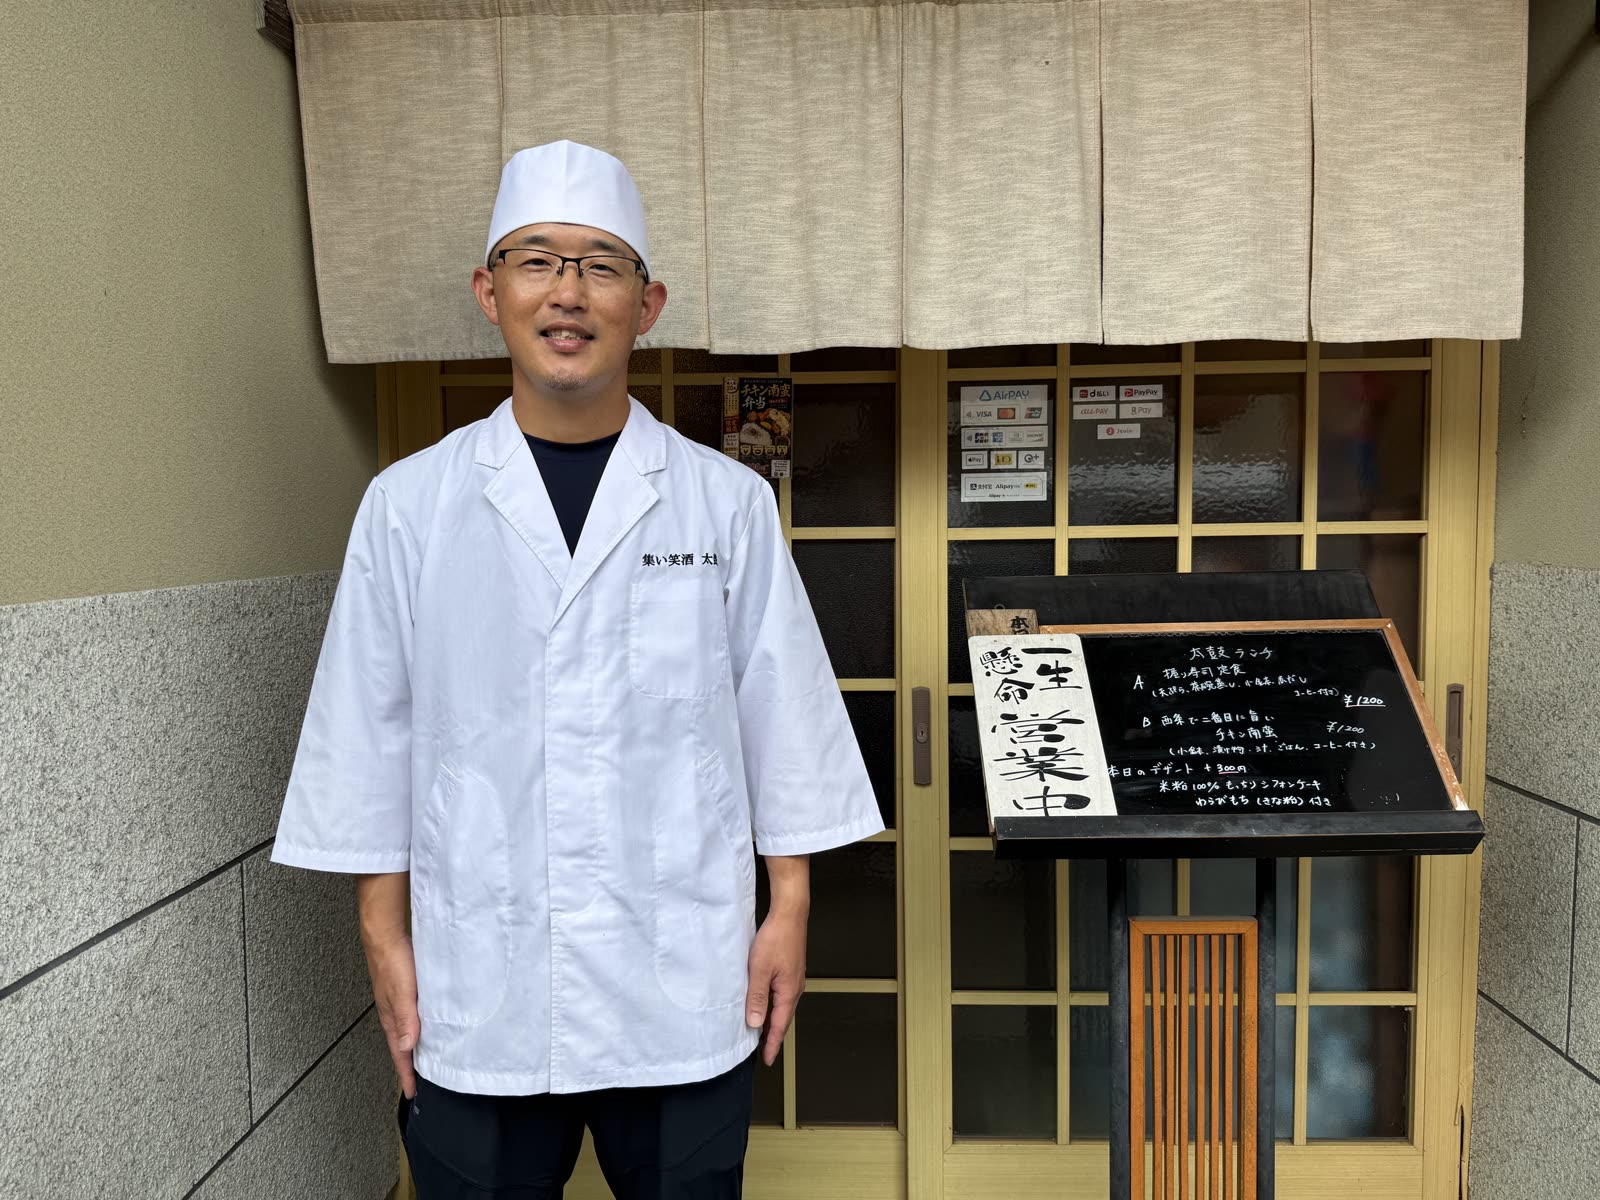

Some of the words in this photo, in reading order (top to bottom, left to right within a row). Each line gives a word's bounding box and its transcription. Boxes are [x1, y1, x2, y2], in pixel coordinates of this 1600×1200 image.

[740, 383, 791, 398] チキン南蛮
[993, 389, 1030, 400] AirPAY
[1090, 388, 1109, 397] d払い
[1134, 387, 1158, 397] PayPay
[741, 395, 766, 411] 弁当
[976, 410, 992, 418] VISA
[1138, 407, 1151, 416] Pay
[642, 553, 694, 567] 集い笑酒
[979, 646, 1035, 705] 懸命
[1133, 674, 1145, 690] A
[1142, 716, 1152, 728] B
[1215, 725, 1279, 742] チキン南蛮
[990, 709, 1092, 817] 営業中
